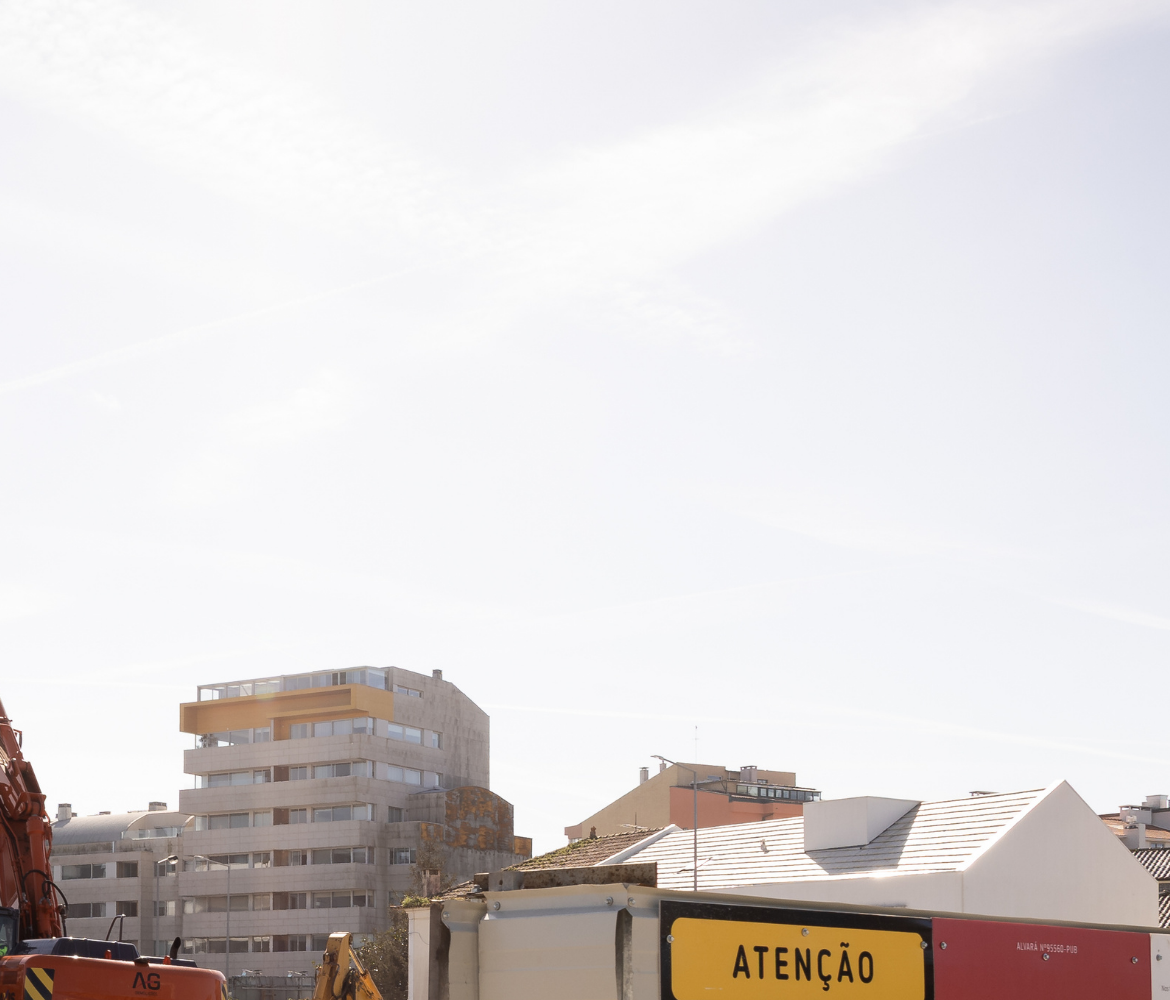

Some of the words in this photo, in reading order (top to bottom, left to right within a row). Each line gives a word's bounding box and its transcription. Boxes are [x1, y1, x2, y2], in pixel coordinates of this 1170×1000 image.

[1016, 941, 1038, 951] ALVARÁ
[732, 941, 874, 991] ATENÇÃO
[132, 971, 161, 990] AG
